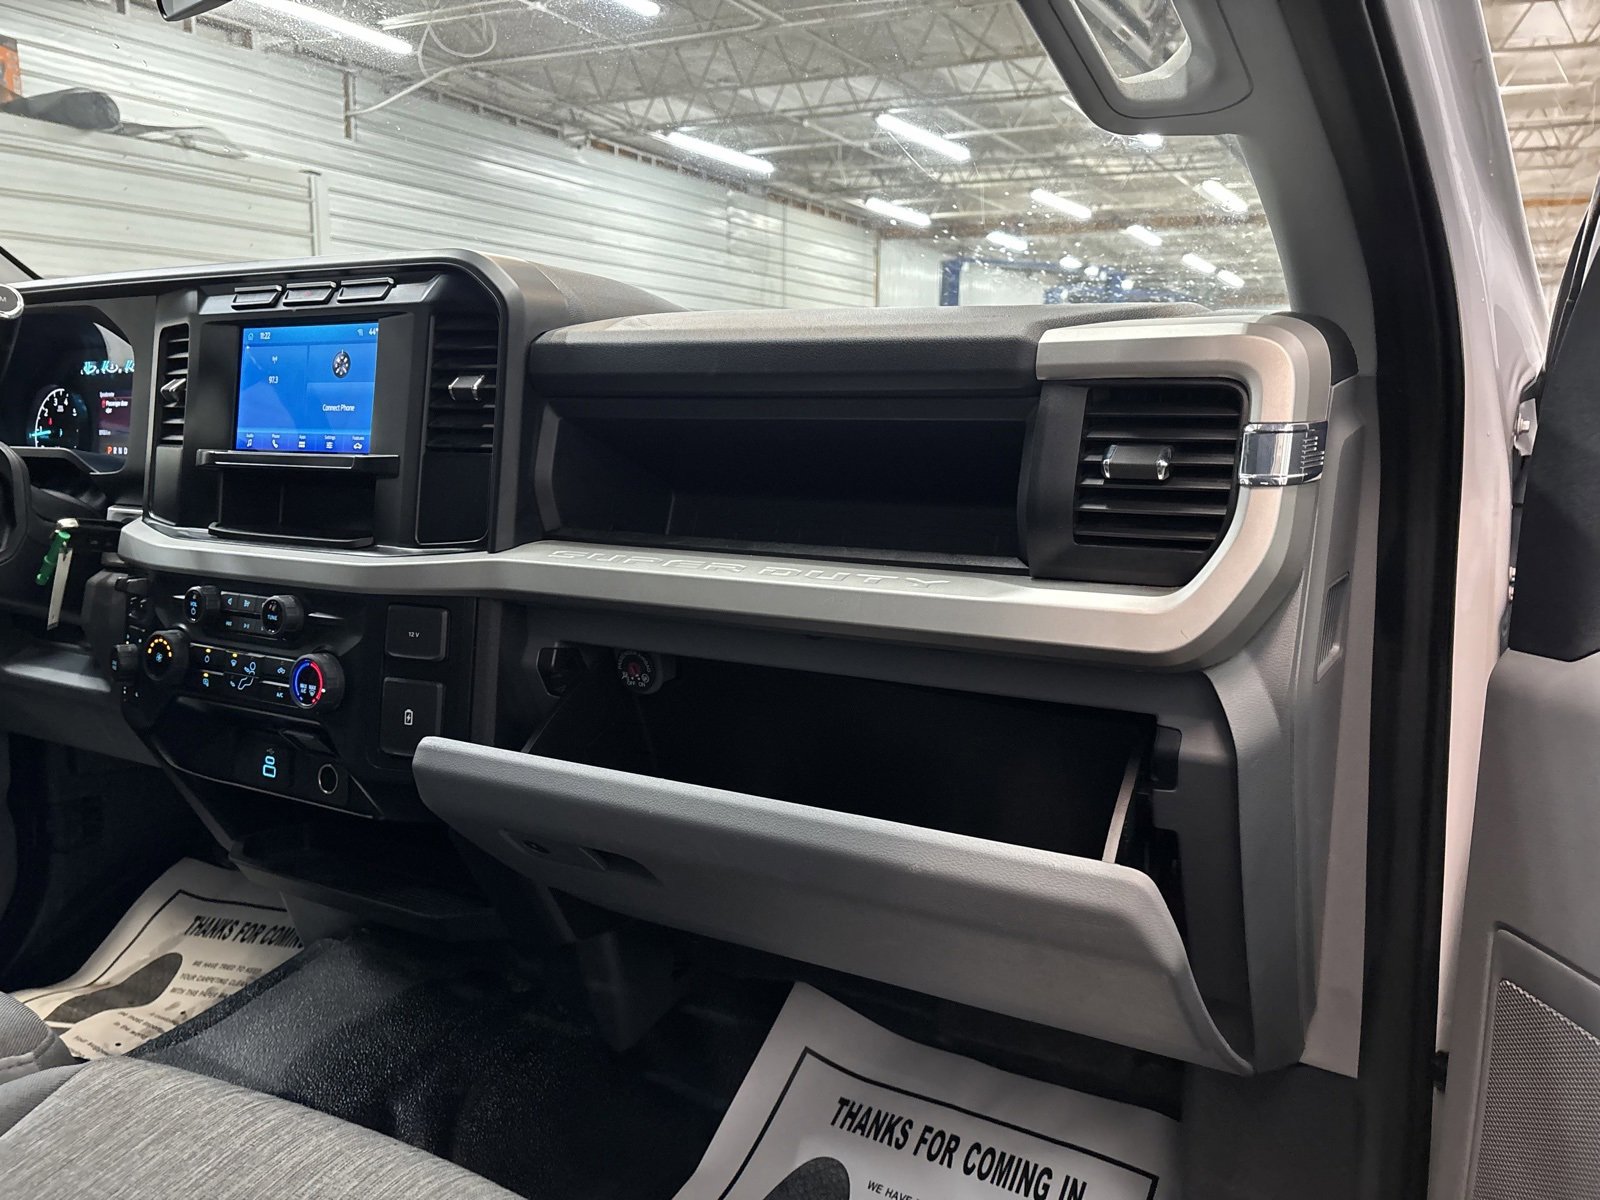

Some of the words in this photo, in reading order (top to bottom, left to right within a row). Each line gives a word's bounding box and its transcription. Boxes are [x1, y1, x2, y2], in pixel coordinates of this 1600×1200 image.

[322, 404, 339, 412] Connect
[339, 404, 355, 412] Phone
[548, 550, 747, 573] SUPER
[758, 566, 951, 588] DUTY
[184, 915, 240, 942] THANKS
[232, 921, 266, 944] FOR
[829, 1096, 914, 1150] THANKS
[913, 1124, 961, 1169] FOR
[962, 1142, 1053, 1200] COMING
[1058, 1174, 1088, 1200] IN
[867, 1180, 884, 1194] WE
